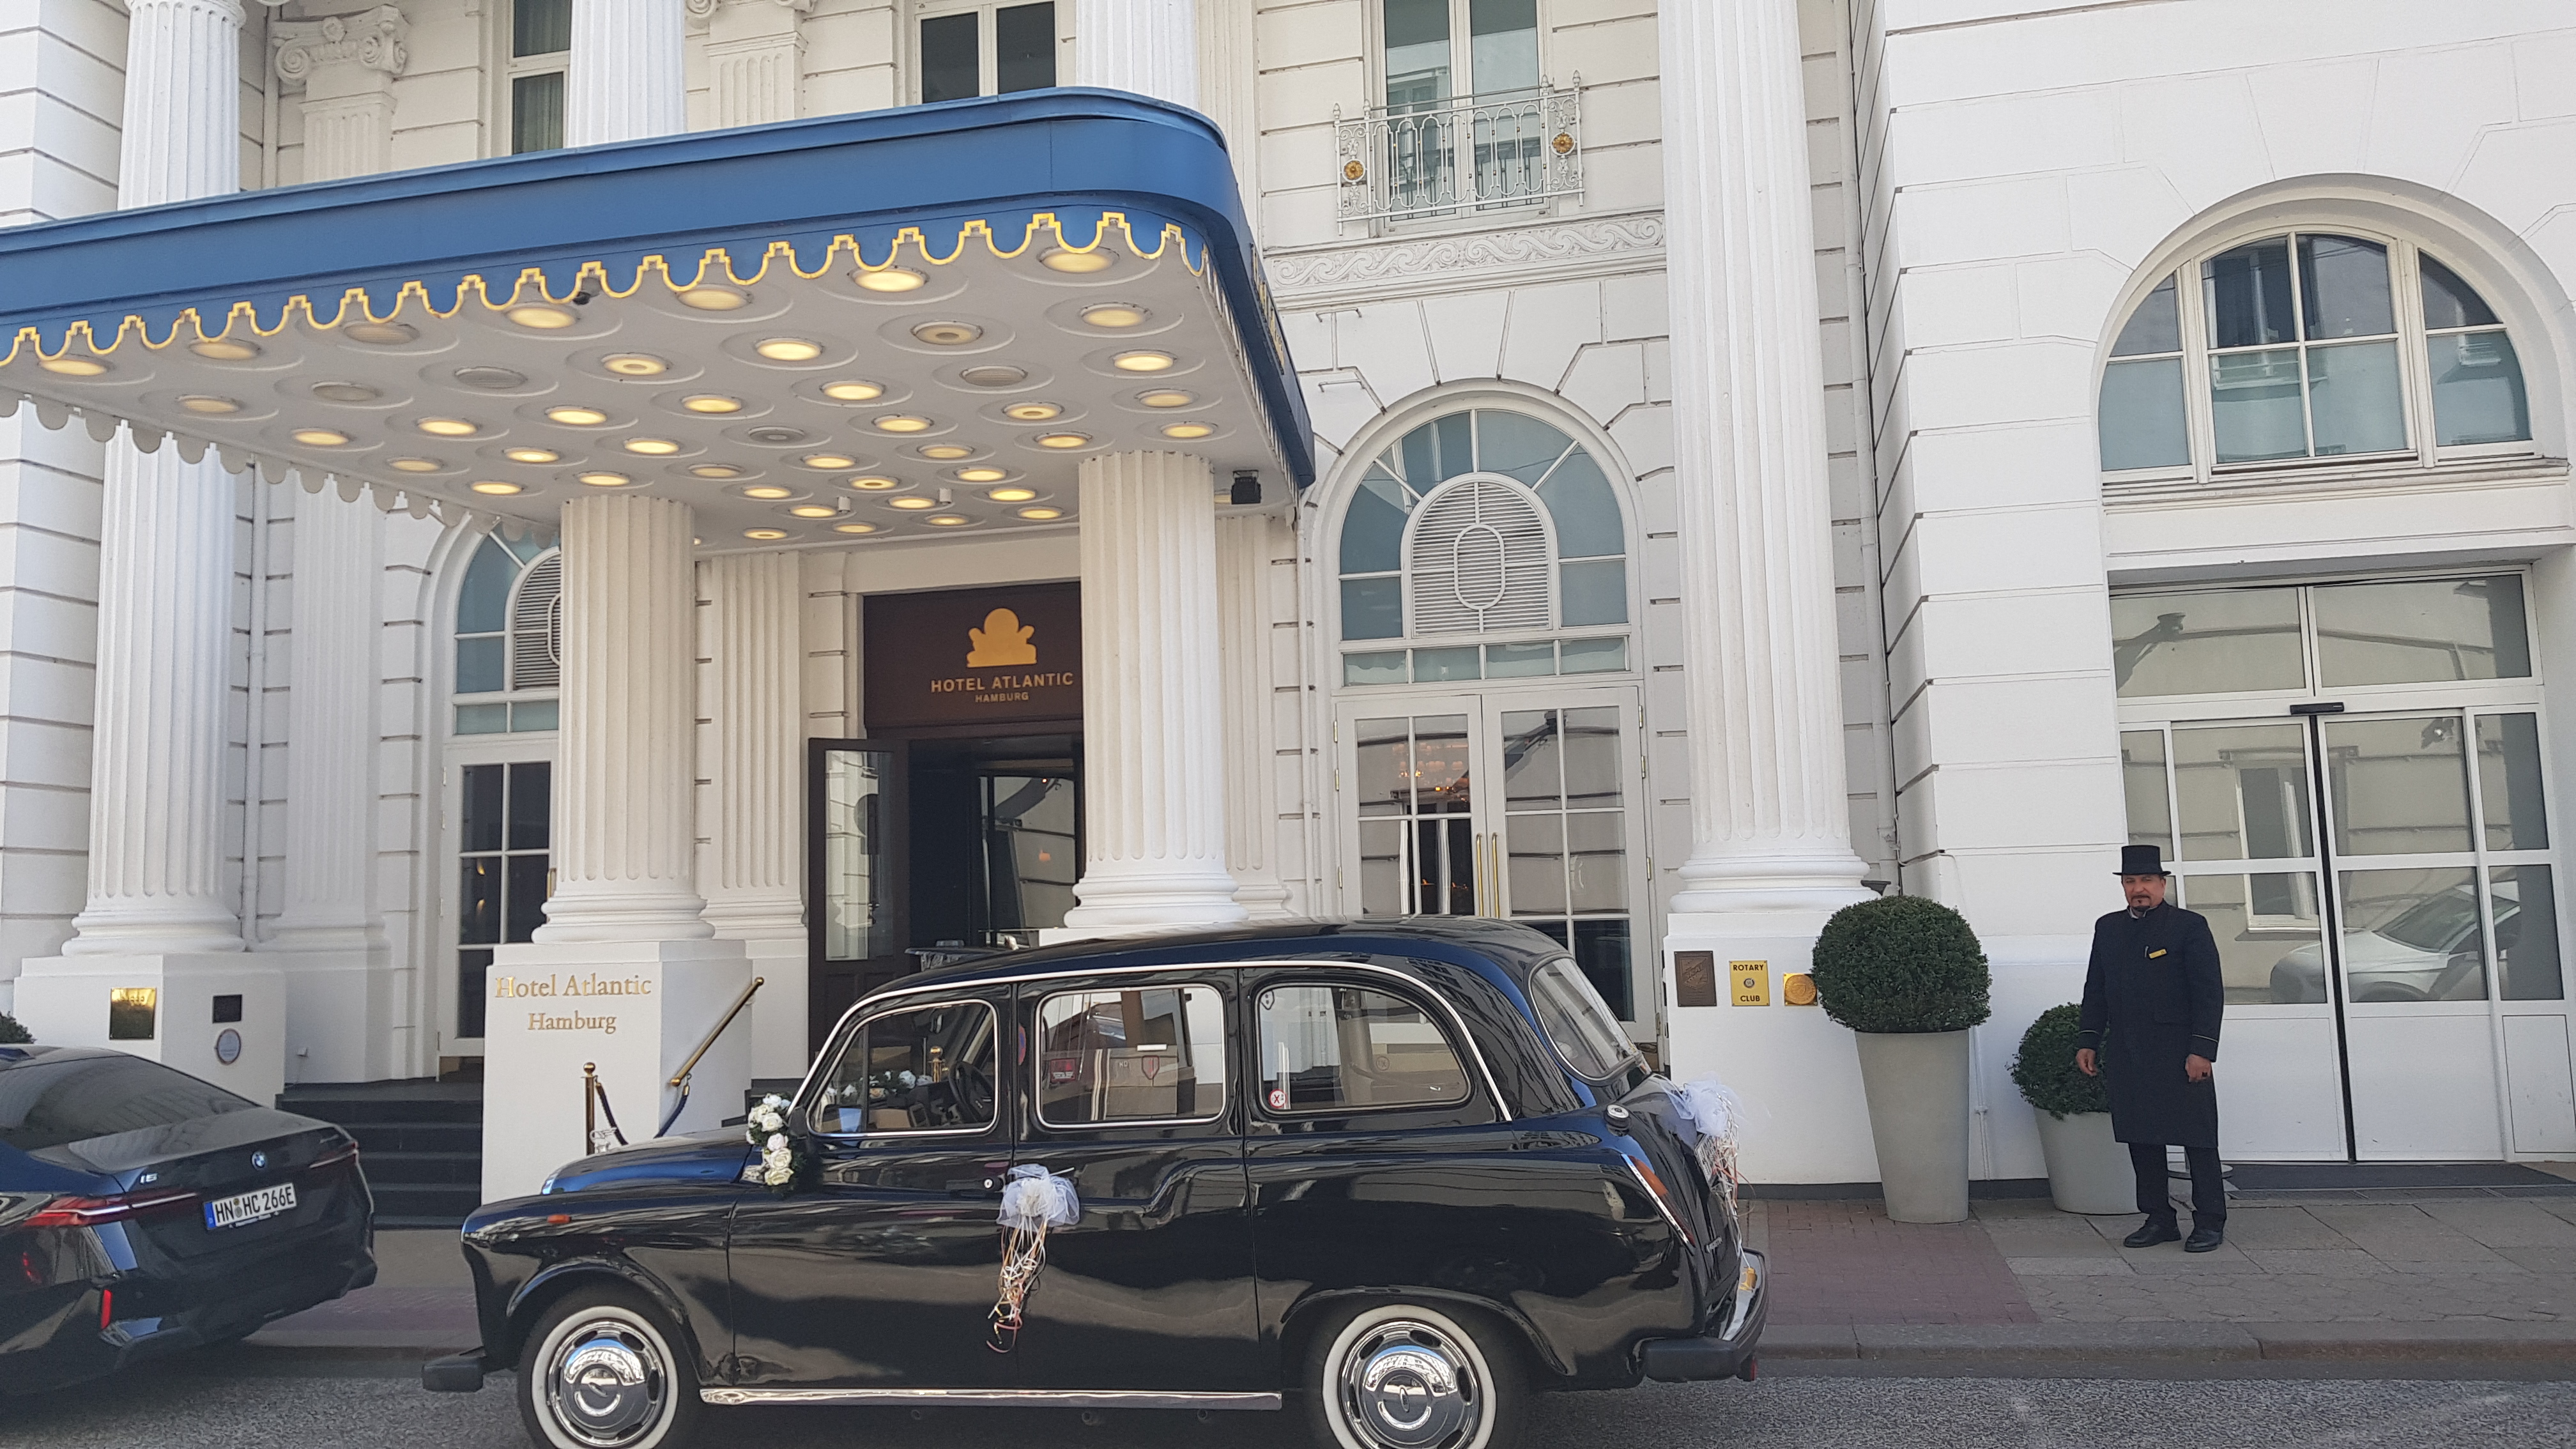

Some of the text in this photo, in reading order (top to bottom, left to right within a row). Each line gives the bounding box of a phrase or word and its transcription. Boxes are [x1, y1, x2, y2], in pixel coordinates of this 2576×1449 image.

[930, 672, 1073, 693] HOTEL ATLANTIC
[975, 692, 1029, 703] HAMBURG
[495, 972, 652, 998] Hotel Atlantic
[527, 1010, 617, 1034] Hamburg
[215, 1201, 234, 1223] HN
[242, 1195, 261, 1216] HC
[262, 1186, 295, 1211] 266E
